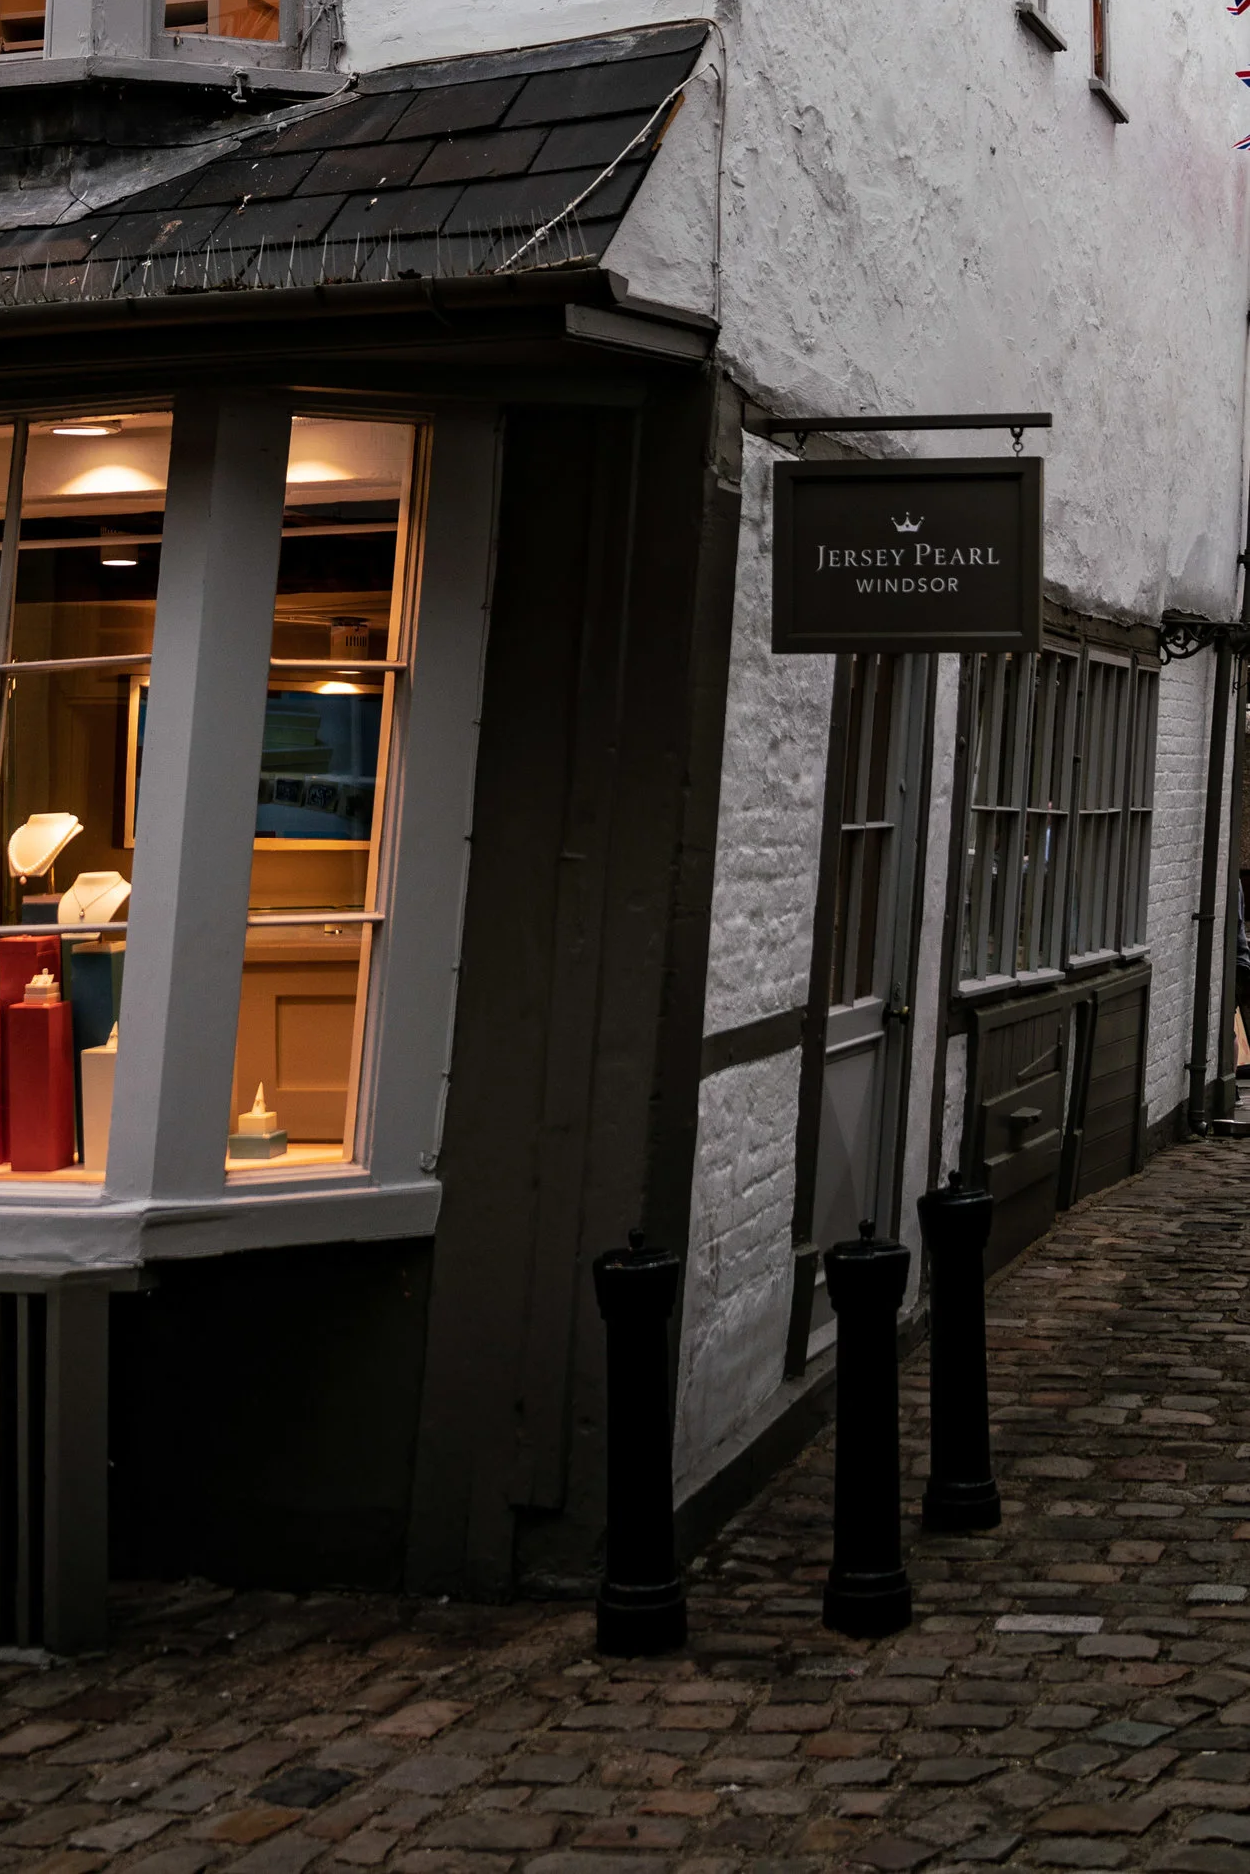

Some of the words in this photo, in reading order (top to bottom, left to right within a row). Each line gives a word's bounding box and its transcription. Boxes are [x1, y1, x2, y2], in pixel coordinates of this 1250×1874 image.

[815, 544, 905, 572] JERSEY
[913, 542, 1000, 566] PEARL
[856, 577, 959, 594] WINDSOR
